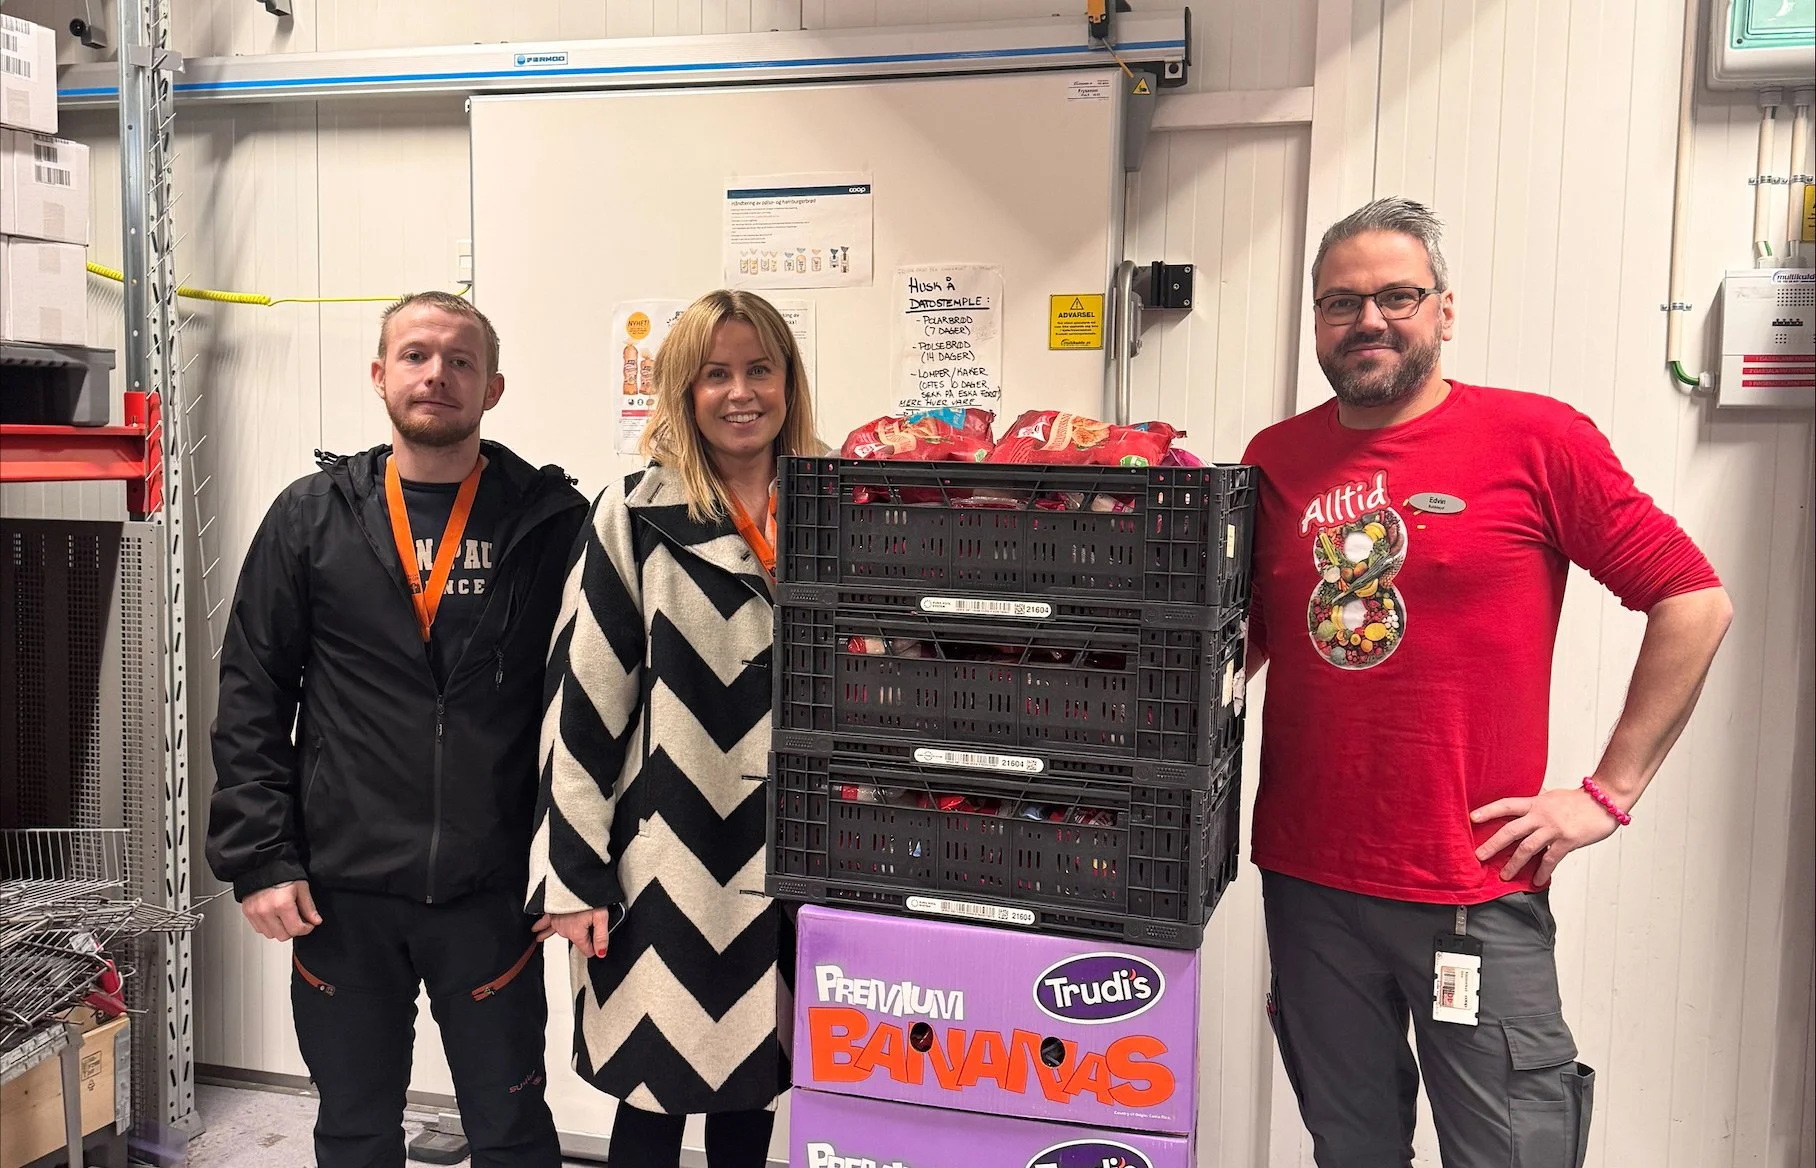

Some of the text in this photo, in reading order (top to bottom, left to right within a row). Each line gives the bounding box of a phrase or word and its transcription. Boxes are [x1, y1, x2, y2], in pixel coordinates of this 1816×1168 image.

[908, 276, 956, 294] HUSK Å
[923, 315, 974, 326] POLARBRØD
[1058, 311, 1096, 319] ADVARSEL
[938, 325, 971, 336] DAGER)
[918, 340, 972, 351] PØLSEBRØD
[938, 350, 976, 362] DAGER)
[1300, 472, 1388, 535] Alltid
[1026, 605, 1049, 614] 21604
[1001, 759, 1024, 767] 21604
[1011, 912, 1032, 921] 21604
[815, 964, 965, 1021] PREMIUM
[1044, 968, 1153, 1009] Trudi's
[807, 1006, 1176, 1108] BANANAS
